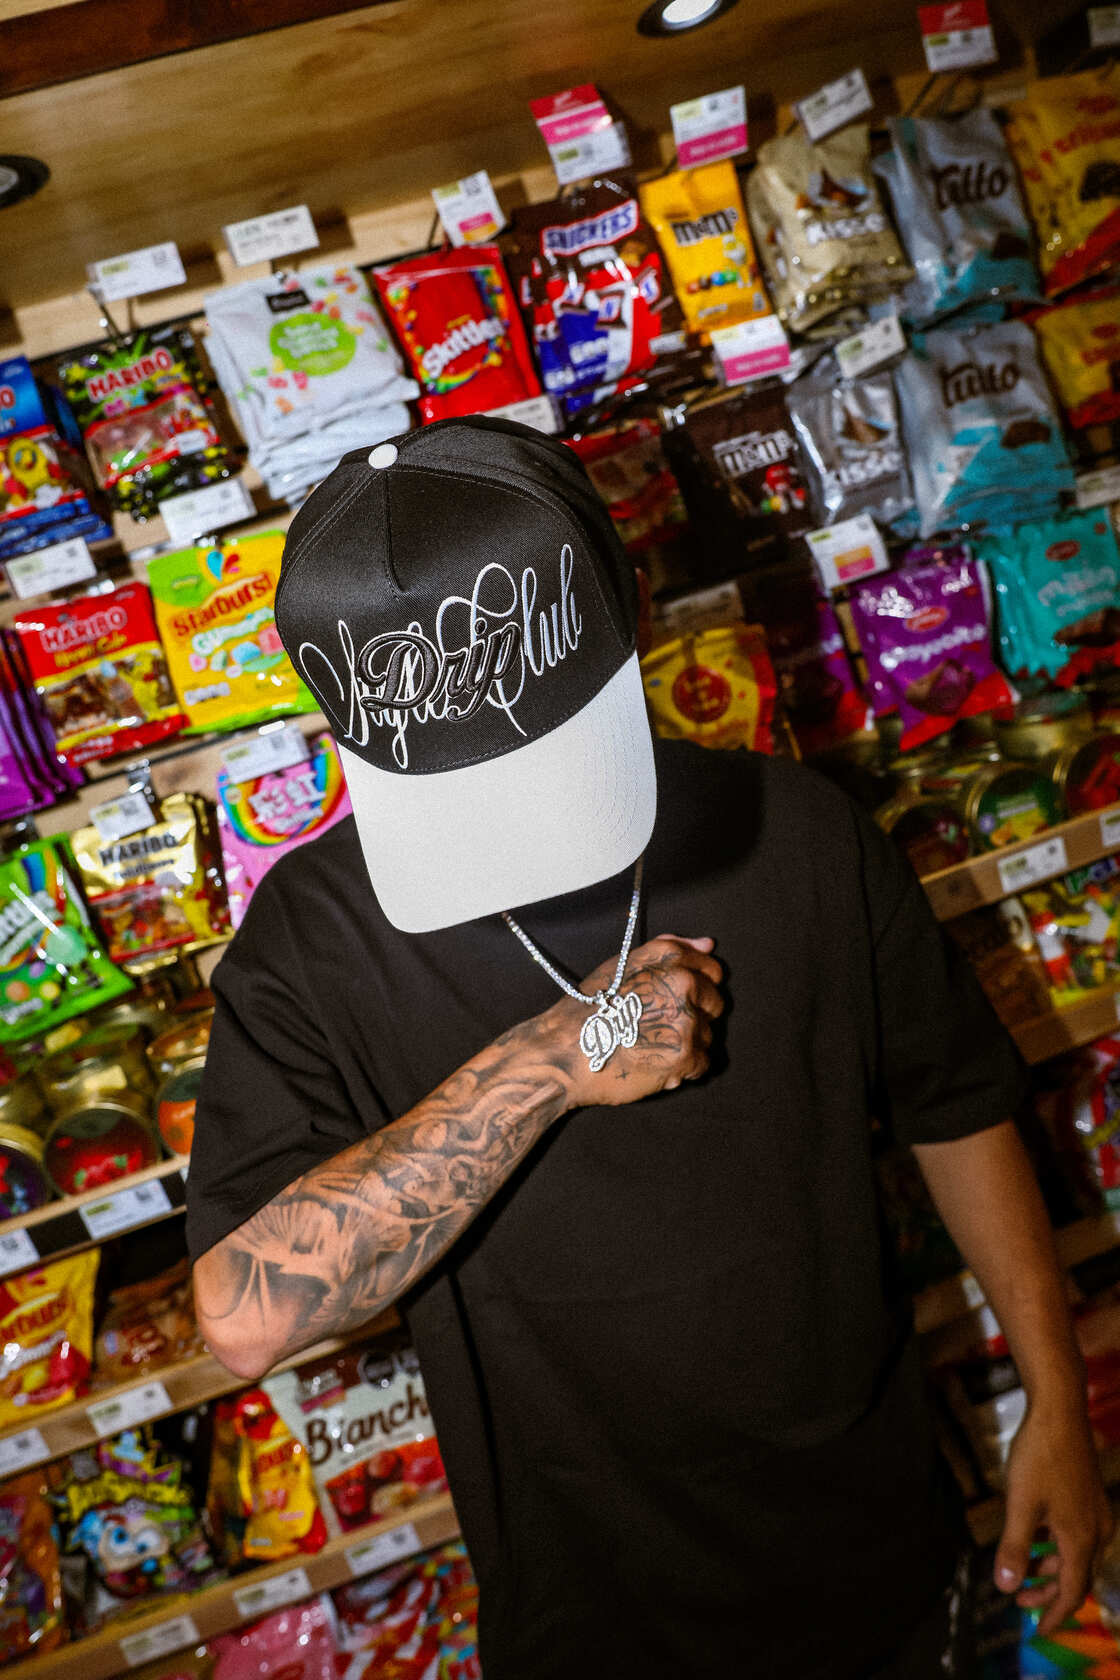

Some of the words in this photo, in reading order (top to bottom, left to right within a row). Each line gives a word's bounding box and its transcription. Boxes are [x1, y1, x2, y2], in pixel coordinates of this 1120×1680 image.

[88, 348, 173, 402] HARIBO
[40, 606, 128, 653] HARIBO
[357, 616, 522, 722] Drip
[99, 832, 179, 867] HARIBO
